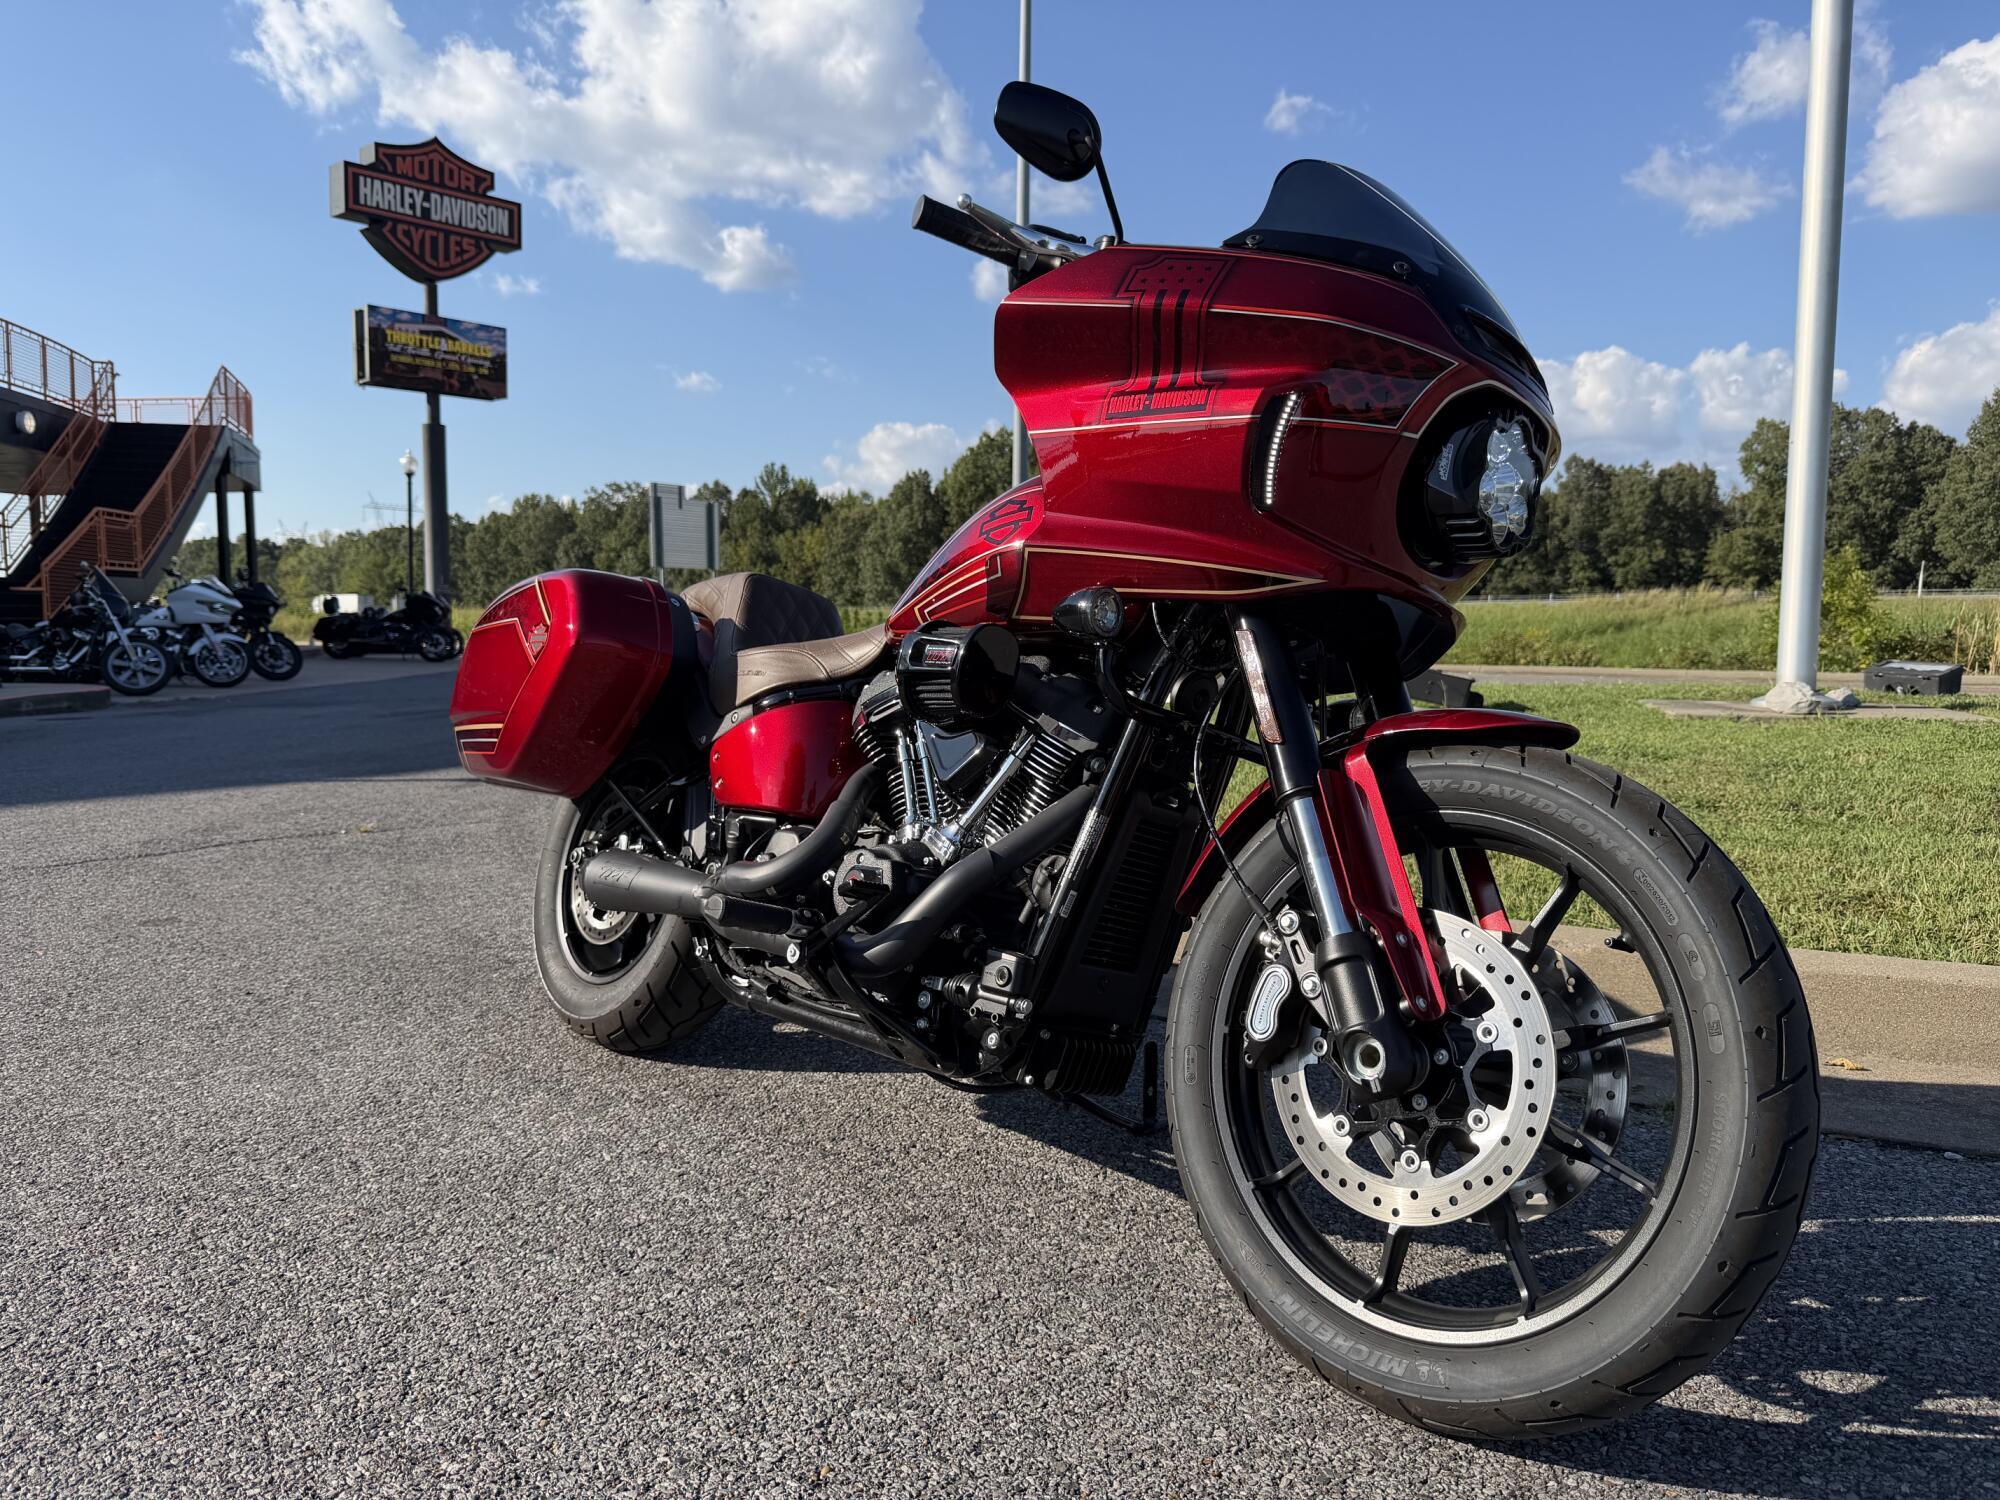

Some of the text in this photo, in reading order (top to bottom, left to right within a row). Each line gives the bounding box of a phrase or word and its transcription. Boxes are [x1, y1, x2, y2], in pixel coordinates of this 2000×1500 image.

[396, 152, 475, 193] MOTOR
[358, 175, 510, 237] HARLEY-DAVIDSON
[396, 223, 476, 269] CYCLES
[385, 328, 440, 351] THROTTLE
[1107, 388, 1208, 414] HARLEY-DAVIDSON
[1416, 778, 1620, 853] EY-DAVIDSON
[1276, 1293, 1411, 1377] MICHELIN
